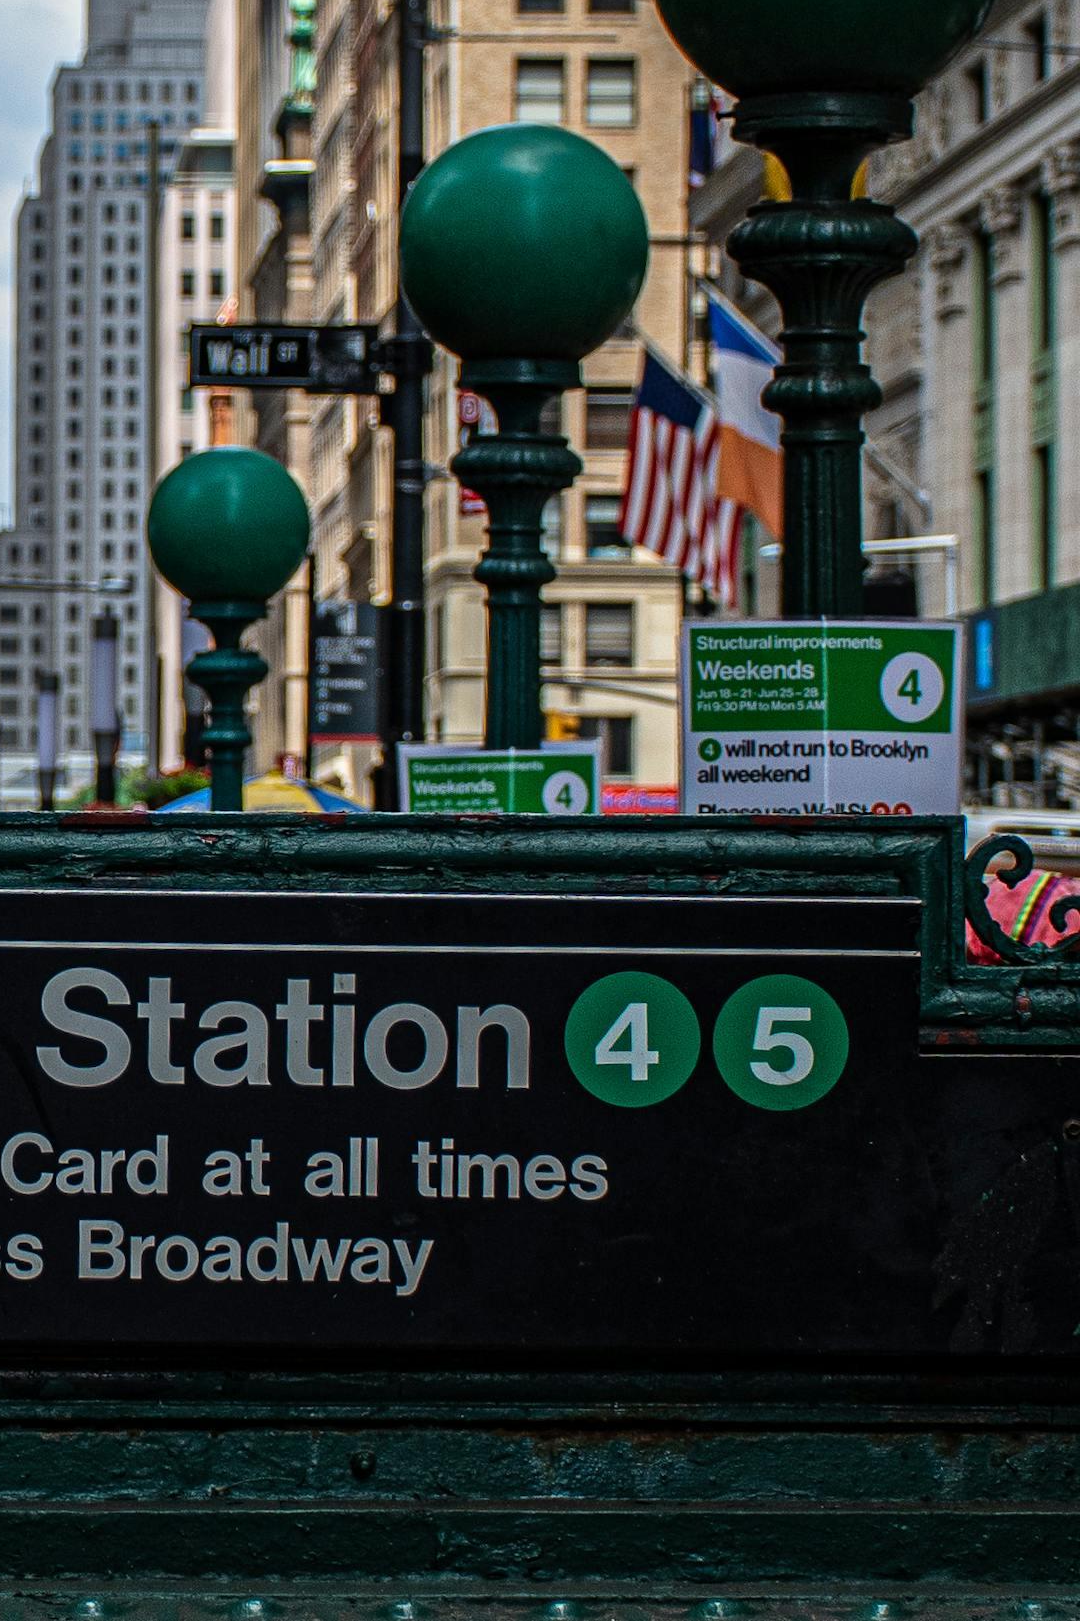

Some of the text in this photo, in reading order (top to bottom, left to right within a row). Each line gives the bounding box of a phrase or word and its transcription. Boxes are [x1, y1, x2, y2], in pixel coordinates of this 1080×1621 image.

[207, 340, 269, 375] Wall
[697, 635, 883, 651] Structural improvements
[697, 659, 815, 681] Weekends
[697, 688, 718, 699] Jun
[758, 687, 779, 698] Jun
[896, 668, 923, 706] 4
[758, 701, 770, 711] to
[771, 700, 795, 711] Mon
[725, 739, 756, 758] will
[758, 740, 791, 758] not
[793, 743, 825, 758] run
[829, 740, 848, 758] to
[851, 739, 928, 762] Brooklyn
[697, 764, 810, 783] all weekend
[35, 966, 531, 1091] Station
[594, 1002, 660, 1082] 4
[748, 1006, 815, 1087] 5
[201, 1137, 272, 1198] at
[303, 1135, 380, 1198] all
[410, 1136, 609, 1202] times
[77, 1218, 435, 1297] Broadway
